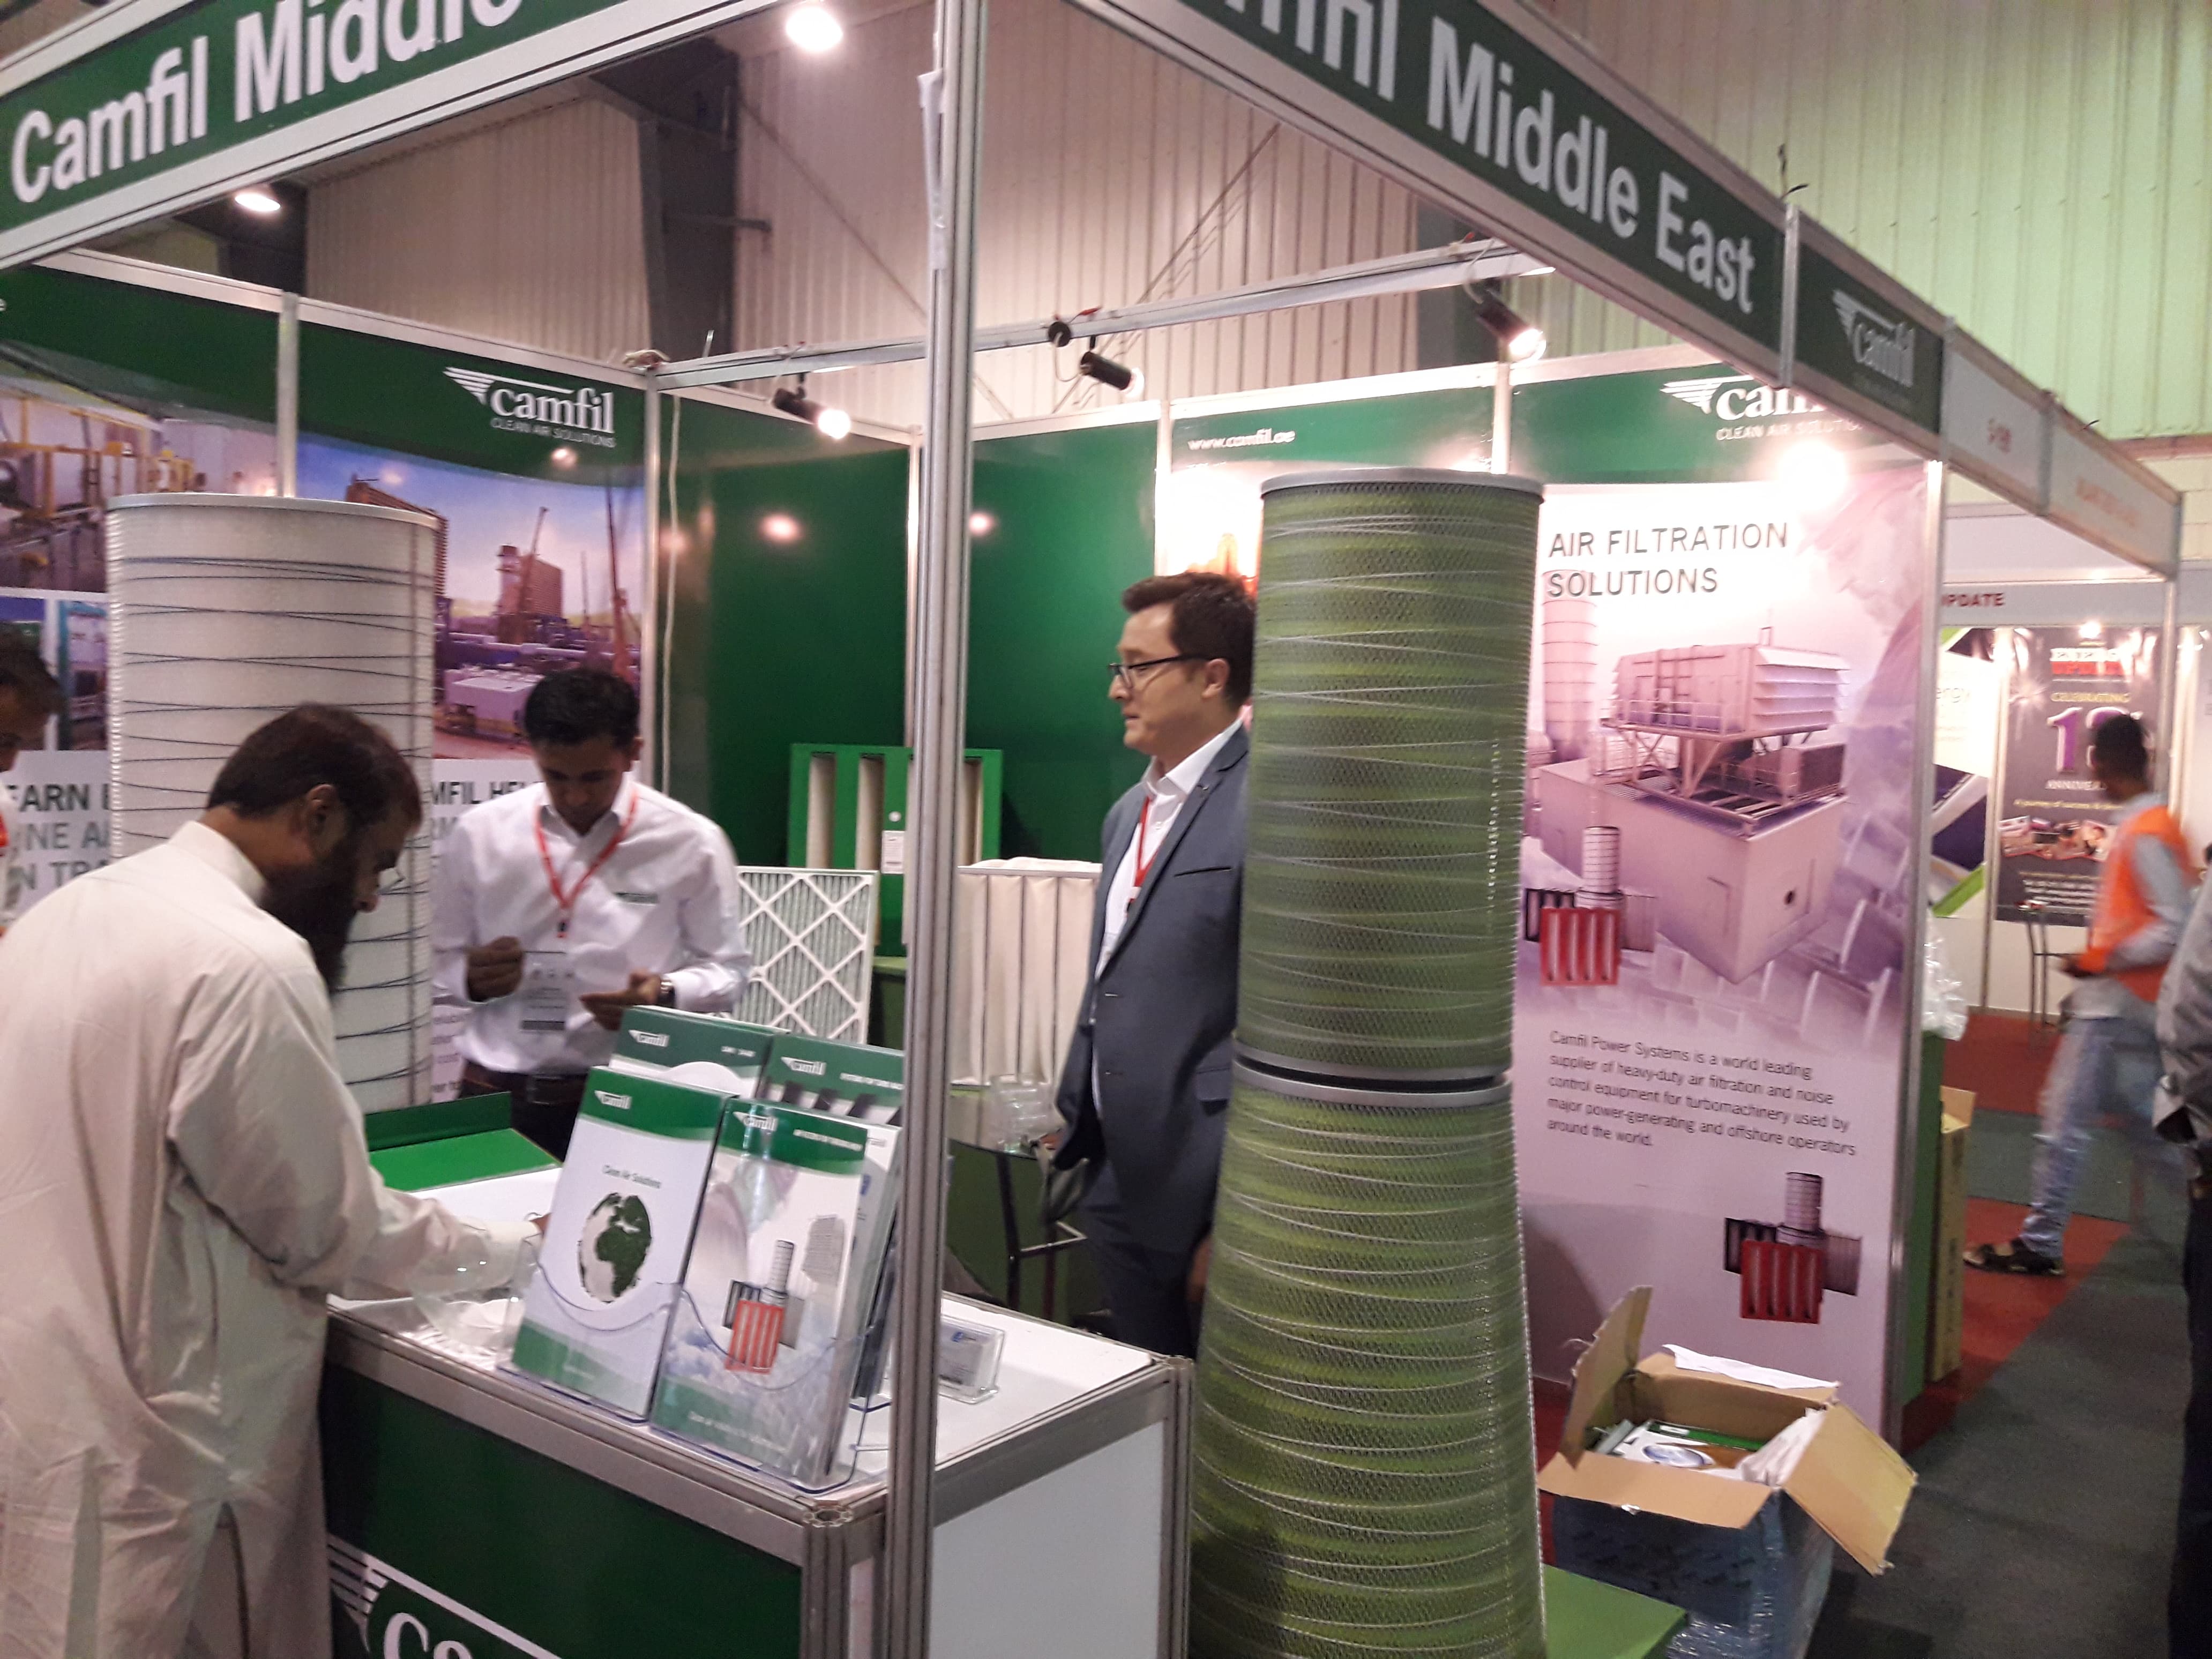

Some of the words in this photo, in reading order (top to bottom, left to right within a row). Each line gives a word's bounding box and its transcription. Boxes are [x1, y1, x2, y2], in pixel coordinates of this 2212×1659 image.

[12, 35, 209, 203] Camfil
[1426, 16, 1639, 238] Middle
[1655, 171, 1755, 314] East
[1548, 531, 1595, 558] AIR
[1608, 522, 1788, 555] FILTRATION
[1546, 567, 1719, 598] SOLUTIONS
[1550, 1030, 1587, 1046] Camfil
[1591, 1036, 1631, 1052] Power
[1634, 1042, 1690, 1061] Systems
[1695, 1052, 1704, 1064] is
[1709, 1055, 1716, 1065] a
[1722, 1056, 1759, 1071] world
[1763, 1058, 1813, 1081] leading
[1550, 1055, 1597, 1071] supplier
[1601, 1060, 1615, 1072] of
[1617, 1063, 1684, 1086] heavy-duty
[1688, 1074, 1705, 1085] air
[1708, 1074, 1762, 1093] filtration
[1768, 1085, 1792, 1098] and
[1796, 1089, 1834, 1105] noise
[1546, 1119, 1588, 1135] around
[1591, 1125, 1612, 1139] the
[1547, 1097, 1582, 1113] major
[1585, 1104, 1695, 1133] power-generating
[1699, 1122, 1723, 1135] and
[1727, 1123, 1784, 1144] offshore
[1787, 1134, 1857, 1156] operators
[1548, 1076, 1590, 1091] control
[1595, 1083, 1660, 1101] equipment
[1664, 1091, 1682, 1105] for
[1685, 1096, 1789, 1124] turbomachinery
[1793, 1113, 1828, 1127] used
[1832, 1116, 1850, 1133] by
